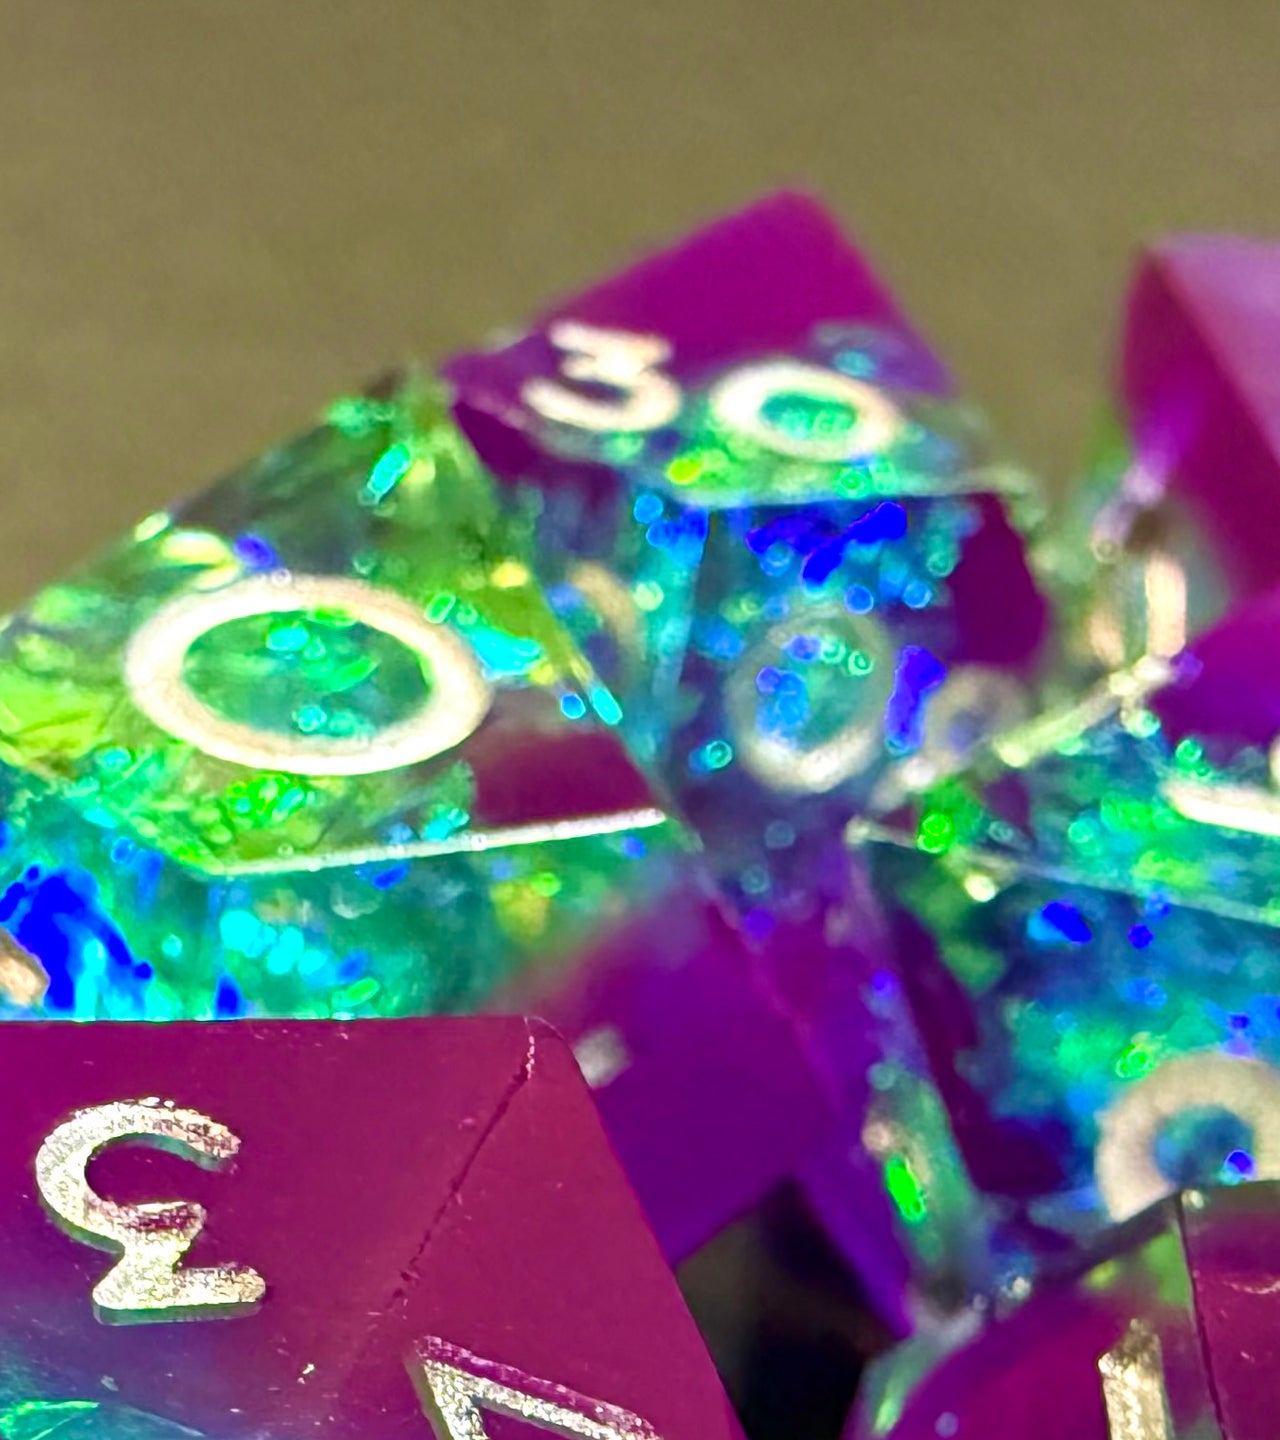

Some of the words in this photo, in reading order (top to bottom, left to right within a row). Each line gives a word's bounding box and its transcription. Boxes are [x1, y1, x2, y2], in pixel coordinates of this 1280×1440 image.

[522, 318, 908, 463] 30
[123, 570, 494, 778] 0
[33, 1096, 266, 1322] 3
